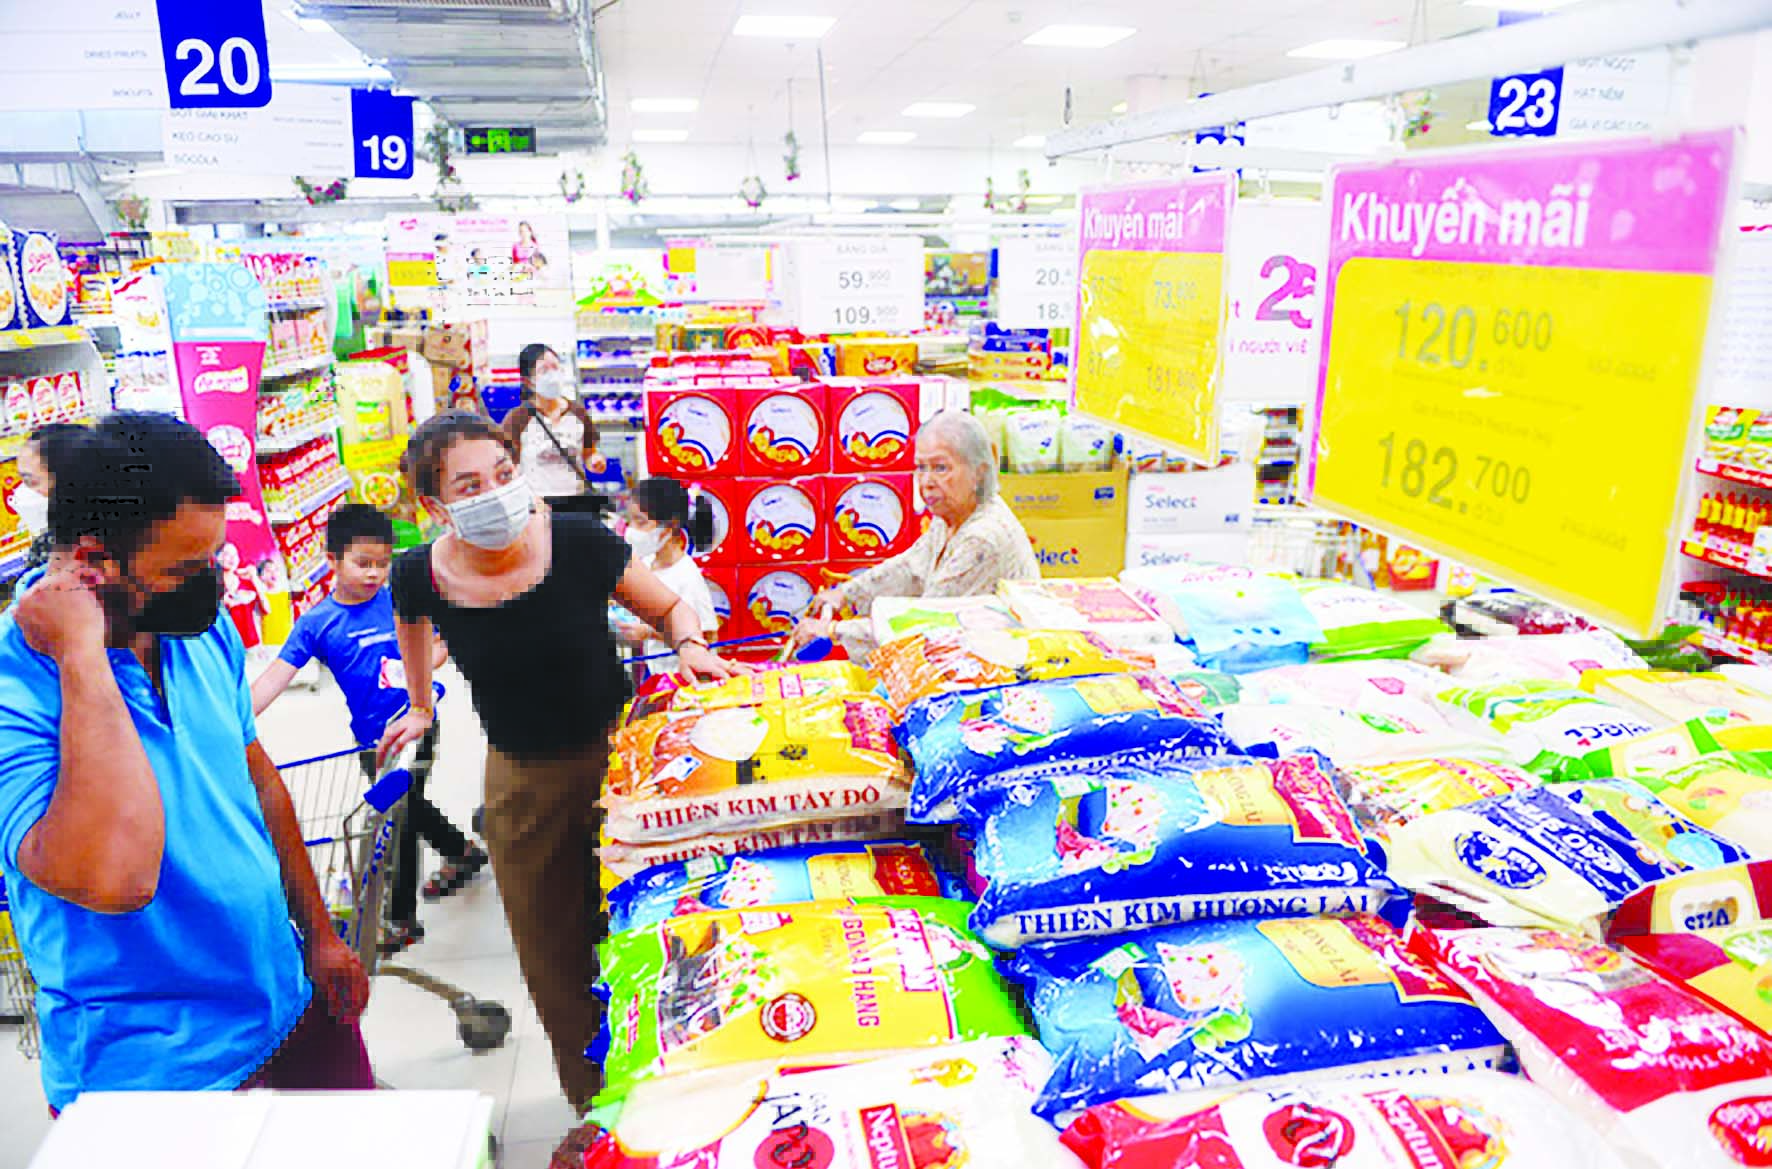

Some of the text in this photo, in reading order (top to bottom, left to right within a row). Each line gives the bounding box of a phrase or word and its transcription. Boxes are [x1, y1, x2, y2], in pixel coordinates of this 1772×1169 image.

[175, 36, 260, 96] 20
[1495, 79, 1556, 130] 23
[363, 135, 408, 171] 19
[1147, 190, 1184, 240] mãi
[1341, 176, 1592, 258] Khuyến mãi
[1144, 493, 1198, 510] Select
[728, 796, 778, 818] KIM
[1124, 900, 1182, 926] KIM
